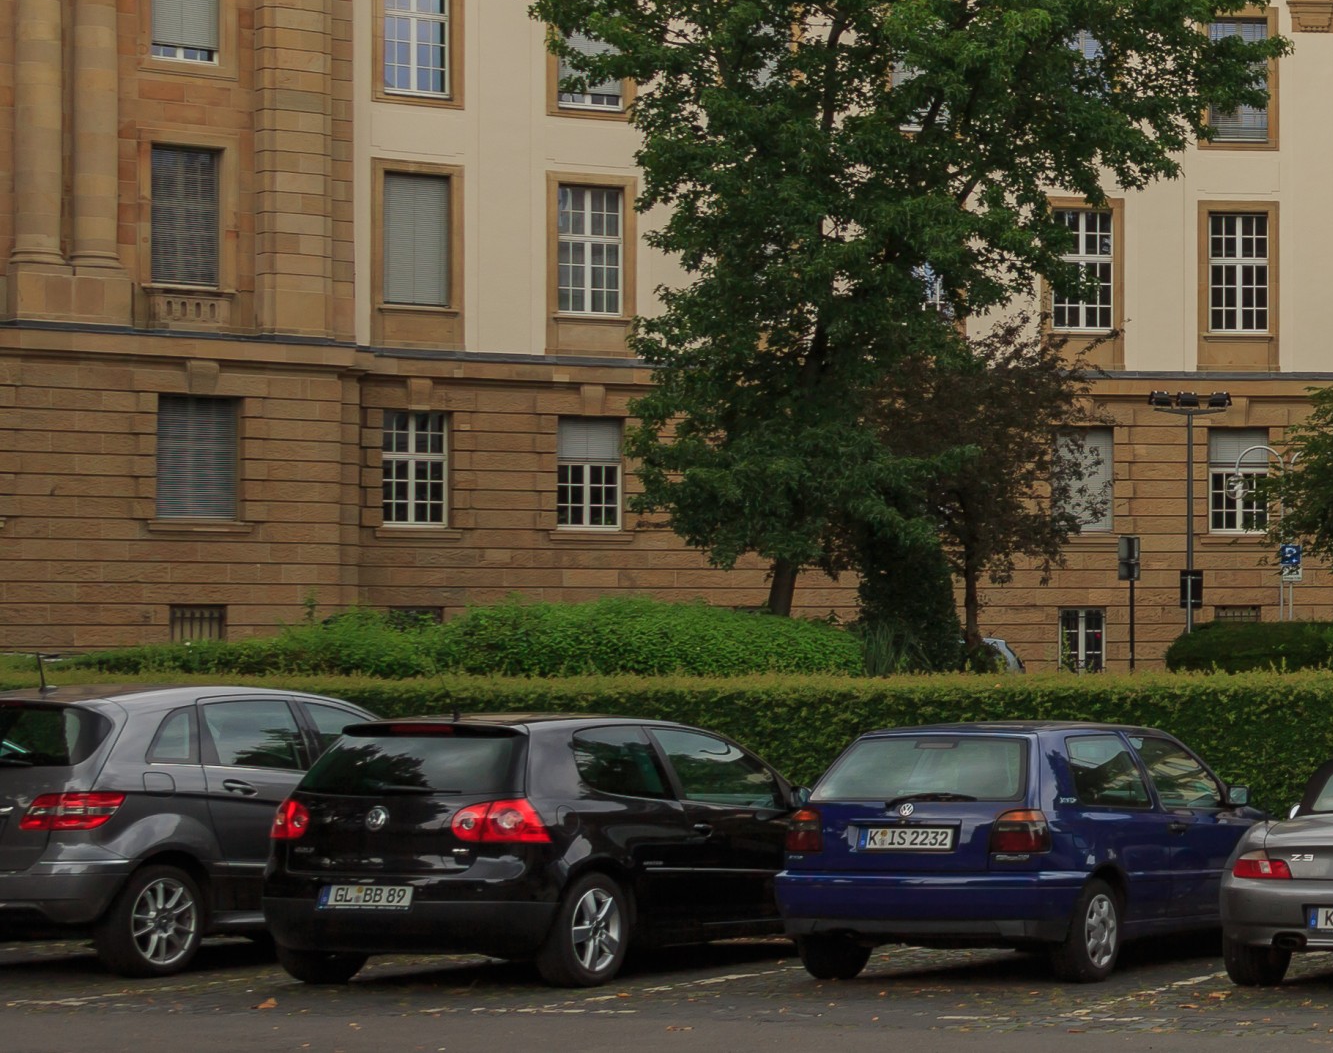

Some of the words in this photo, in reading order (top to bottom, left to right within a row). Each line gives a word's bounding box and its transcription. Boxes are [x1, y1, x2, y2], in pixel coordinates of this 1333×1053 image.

[868, 830, 877, 846] K
[910, 830, 949, 846] 2232
[334, 887, 352, 903] GL
[362, 887, 383, 903] BB
[386, 888, 406, 904] 89
